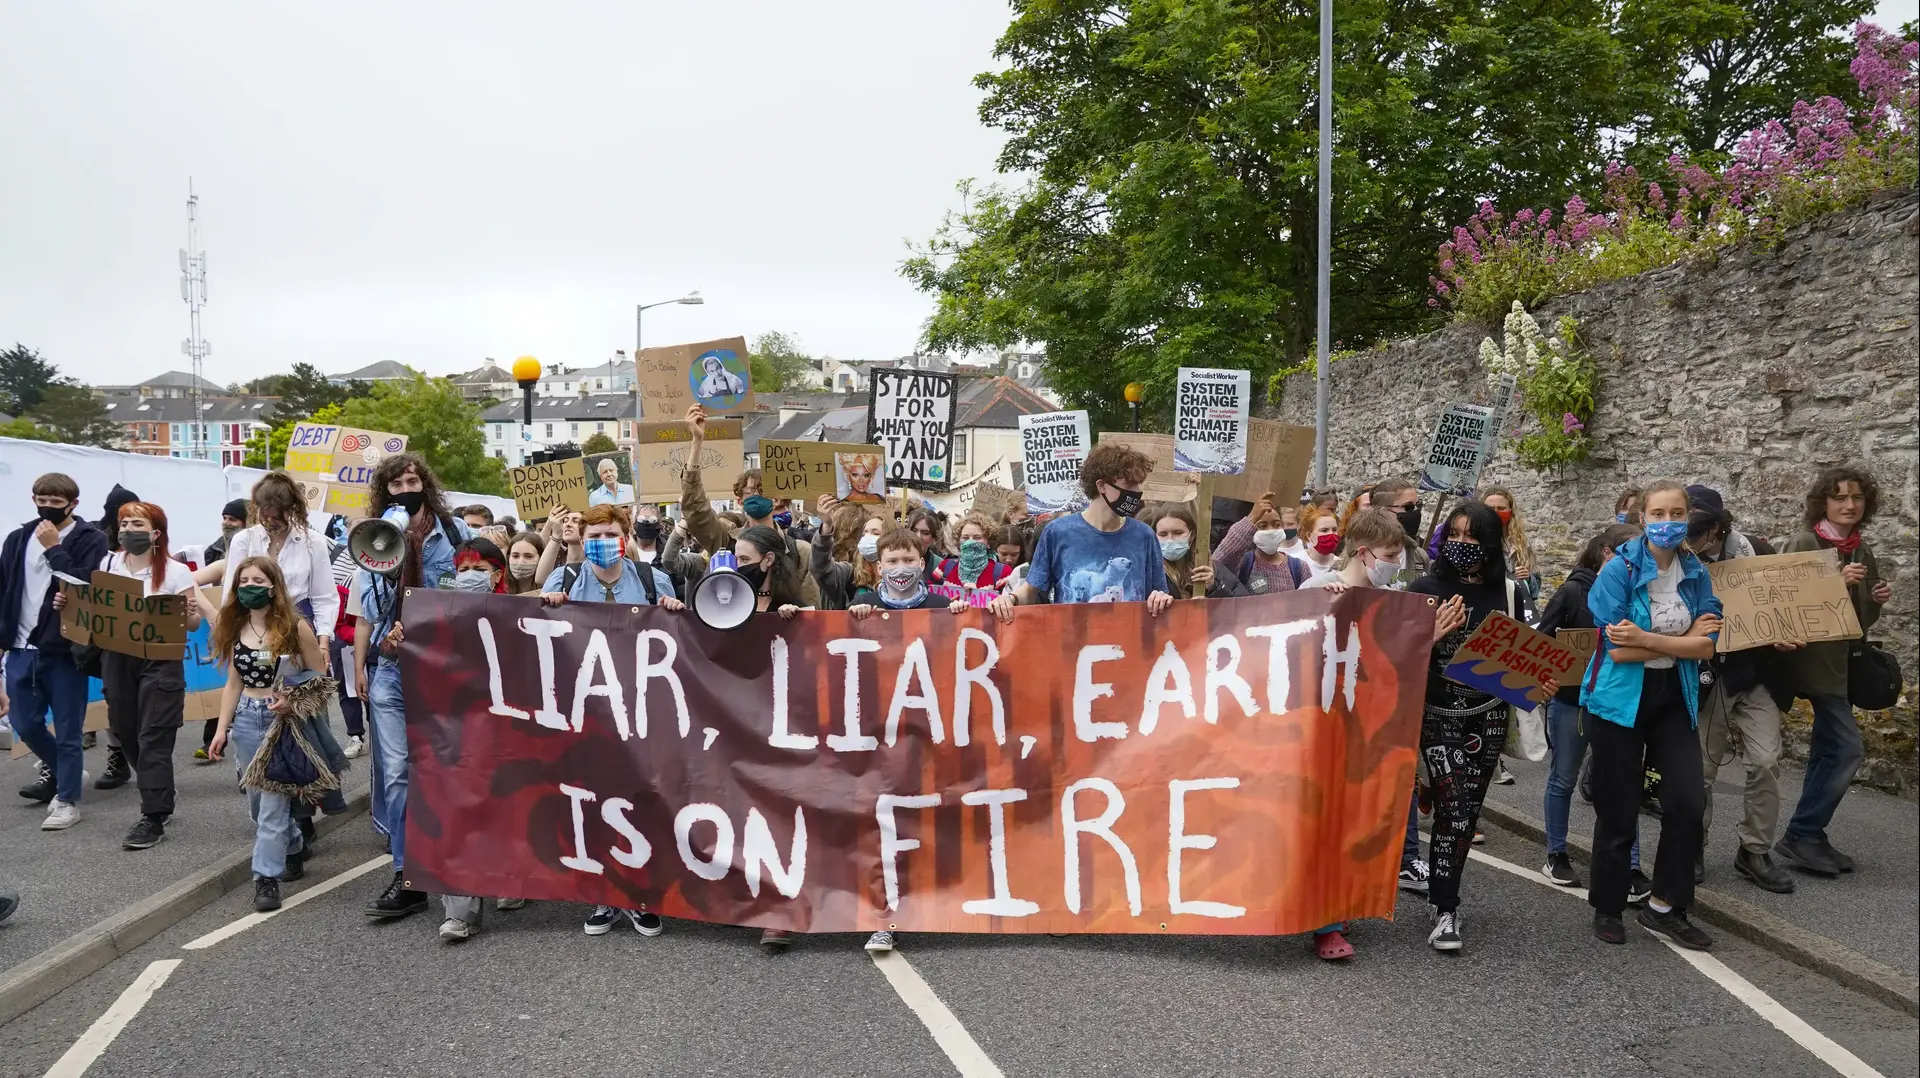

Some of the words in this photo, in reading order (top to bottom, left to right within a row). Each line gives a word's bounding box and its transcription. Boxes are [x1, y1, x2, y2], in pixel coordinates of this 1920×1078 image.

[878, 373, 951, 398] STAND
[1181, 382, 1236, 395] SYSTEM
[895, 398, 936, 417] FOR
[1180, 394, 1238, 408] CHANGE
[1180, 406, 1207, 418] NOT
[873, 419, 915, 436] WHAT
[920, 421, 949, 437] YOU
[1179, 418, 1238, 431] CLIMATE
[1441, 413, 1484, 430] SYSTEM
[292, 427, 336, 447] DEBT
[1023, 424, 1076, 439] SYSTEM
[1179, 430, 1237, 443] CHANGE
[1248, 421, 1294, 444] PEOPLE
[1435, 434, 1458, 446] NOT
[1439, 424, 1483, 440] CHANGE
[765, 445, 801, 458] DONT
[1025, 436, 1080, 450] CHANGE
[1025, 449, 1052, 462] NOT
[1248, 449, 1295, 469] LANET
[1432, 444, 1478, 461] CLIMATE
[815, 462, 832, 473] IT
[892, 461, 924, 480] ON
[1027, 458, 1082, 473] CLIMATE
[1429, 454, 1474, 470] CHANGE
[513, 461, 567, 484] DON'T
[1027, 470, 1081, 485] CHANGE
[514, 476, 584, 498] DISAPPOINT
[776, 473, 808, 491] UP!
[328, 489, 370, 509] JUST
[359, 549, 399, 569] TRUTH!
[1711, 565, 1755, 591] YOU
[1763, 560, 1827, 583] CAN'T
[125, 593, 173, 615] LOVE
[1748, 585, 1799, 606] EAT
[76, 608, 117, 638] NOT
[1724, 598, 1851, 649] MONEY
[1481, 616, 1520, 649] SEA
[1519, 635, 1577, 674] LEVELS
[1566, 632, 1591, 650] NO
[1464, 636, 1501, 658] ARE
[1498, 650, 1554, 685] RISING
[478, 617, 719, 750] LIAR,
[768, 628, 1037, 759] LIAR,
[1073, 614, 1362, 742] EARTH
[559, 783, 653, 874] IS
[674, 802, 808, 899] ON
[875, 777, 1247, 918] FIRE
